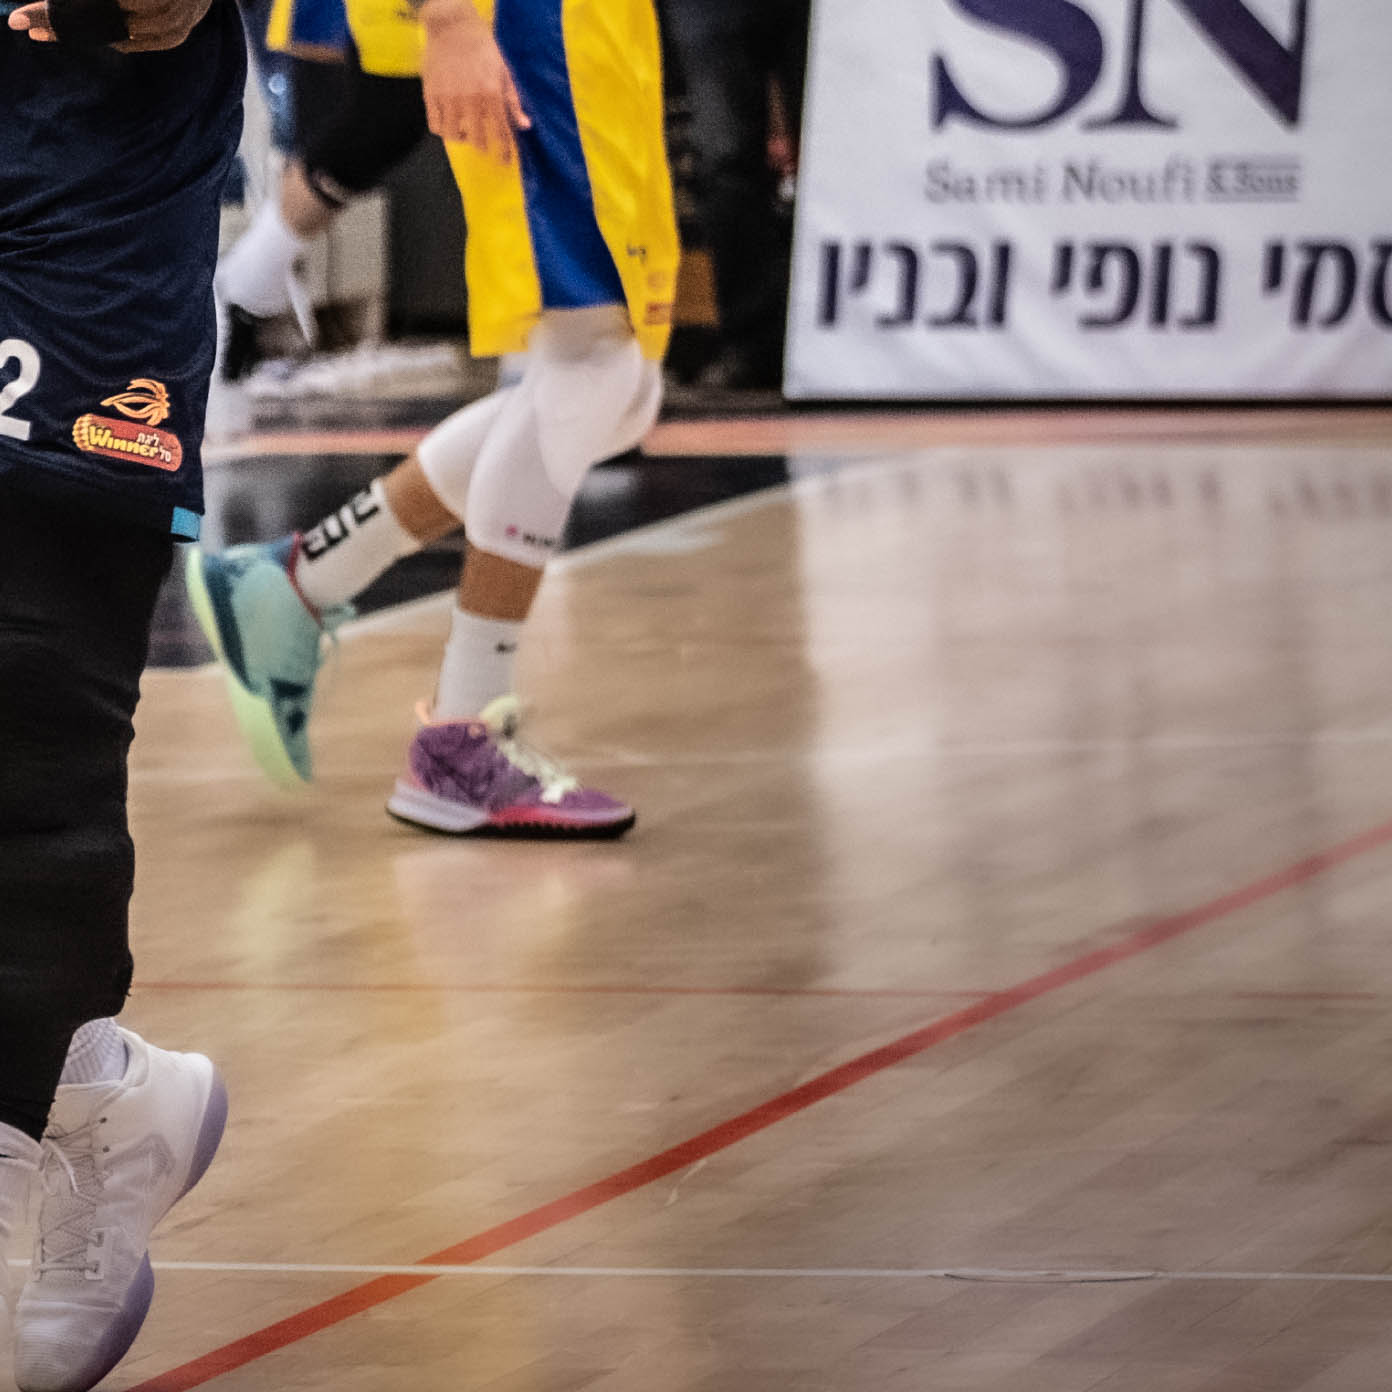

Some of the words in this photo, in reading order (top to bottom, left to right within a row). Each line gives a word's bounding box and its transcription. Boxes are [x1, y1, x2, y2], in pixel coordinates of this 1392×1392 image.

[924, 160, 1046, 205] Sami
[1061, 159, 1193, 205] Noufi
[818, 237, 1014, 329] ובניו
[1047, 237, 1223, 329] נופי
[88, 425, 160, 458] Winner
